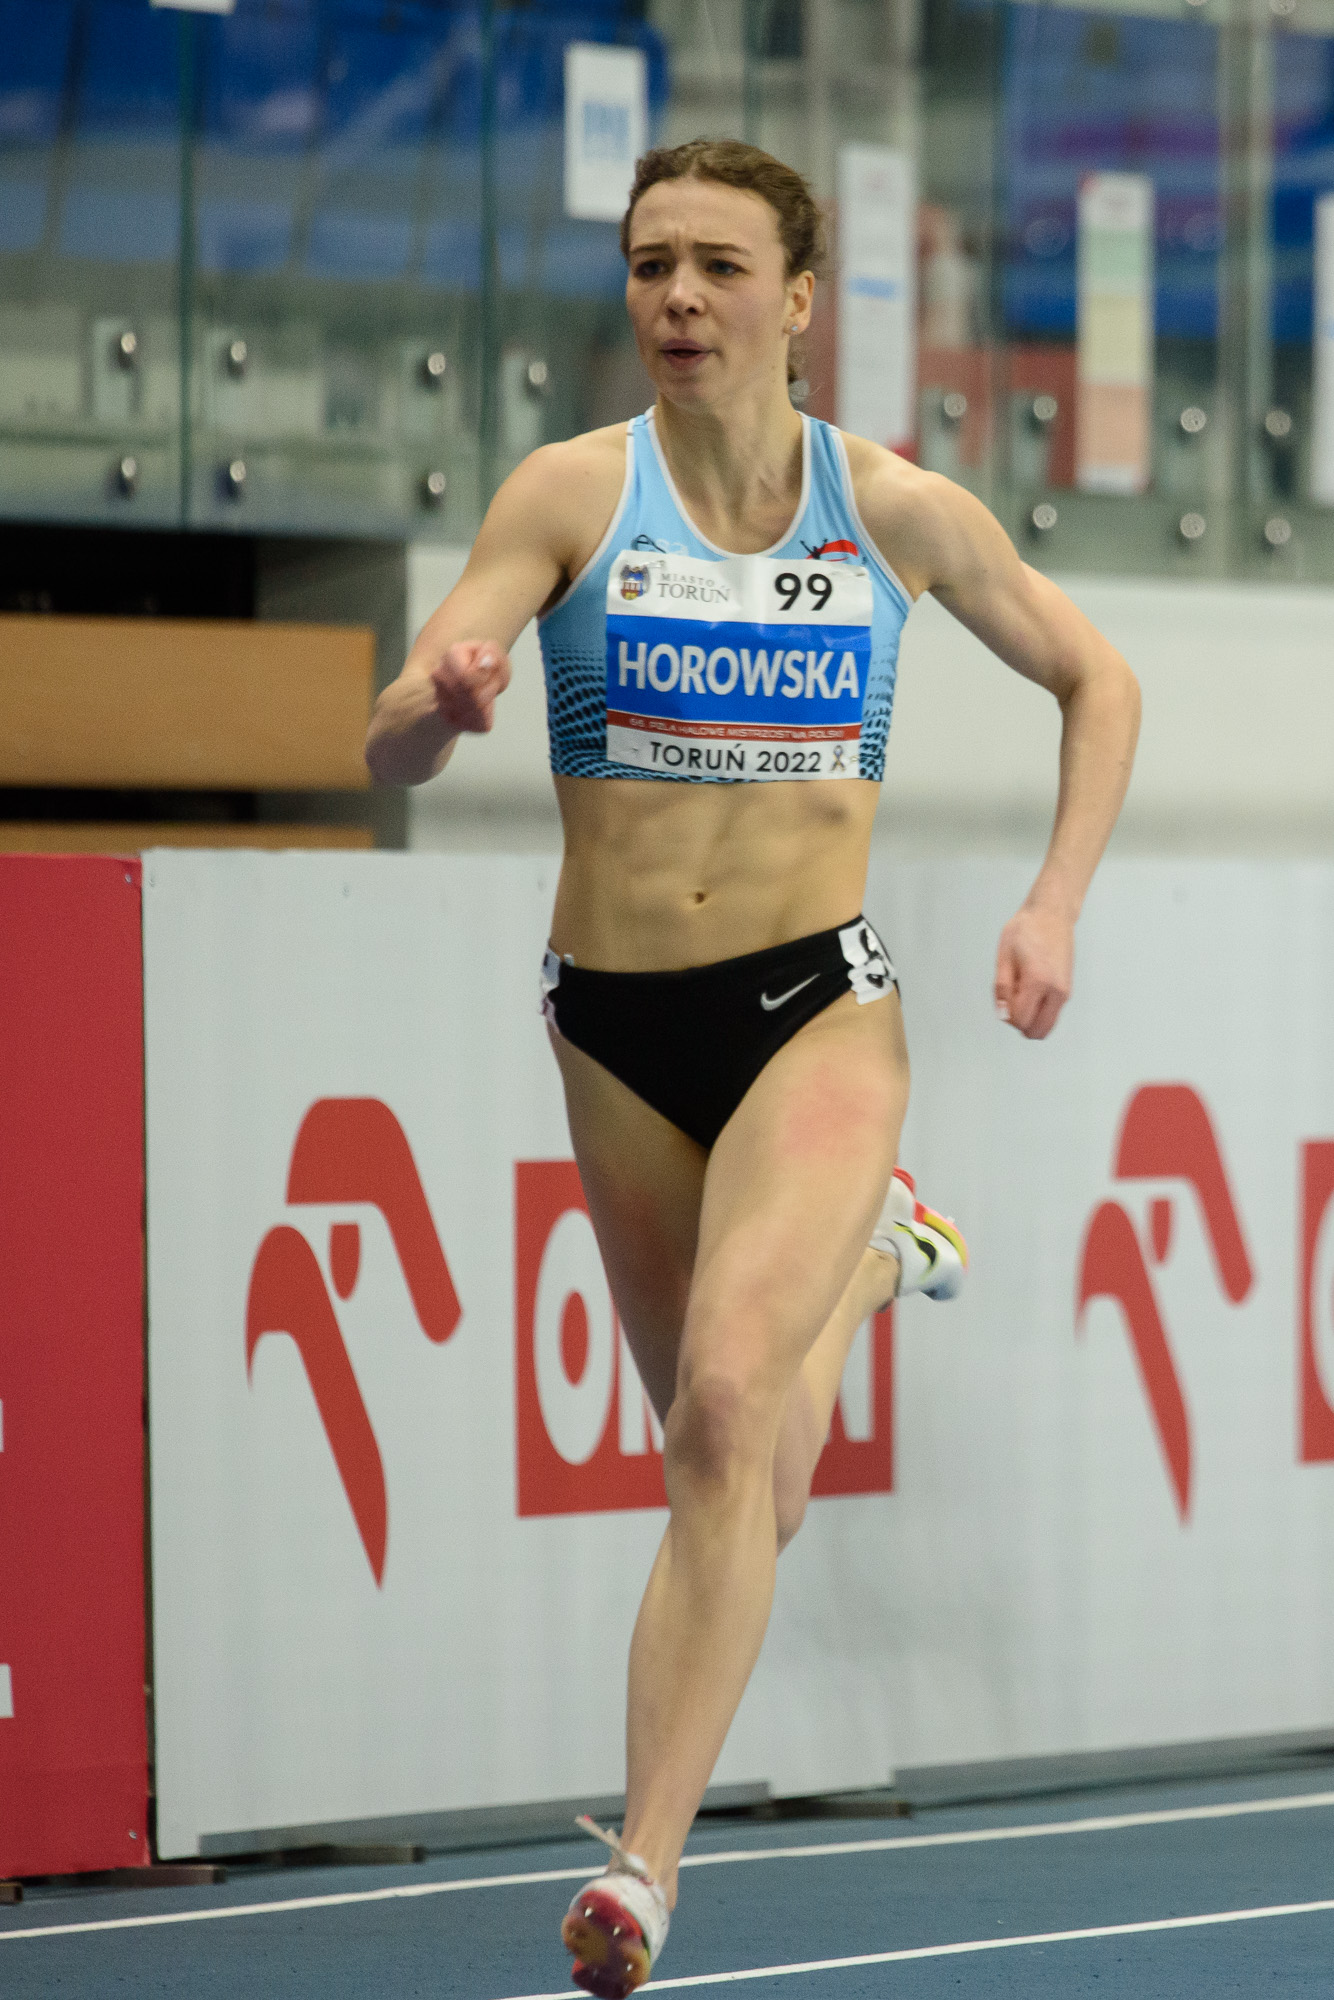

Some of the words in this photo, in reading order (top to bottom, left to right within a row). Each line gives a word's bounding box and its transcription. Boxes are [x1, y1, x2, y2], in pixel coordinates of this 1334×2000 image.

[656, 583, 731, 604] TORUŃ
[661, 573, 715, 588] MIASTO
[774, 572, 832, 612] 99
[618, 641, 860, 699] HOROWSKA
[679, 725, 726, 737] HALOWE
[727, 727, 807, 739] MISTRZOSTWA
[808, 730, 844, 739] POLSKI
[650, 741, 746, 771] TORUŃ
[755, 750, 821, 772] 2022
